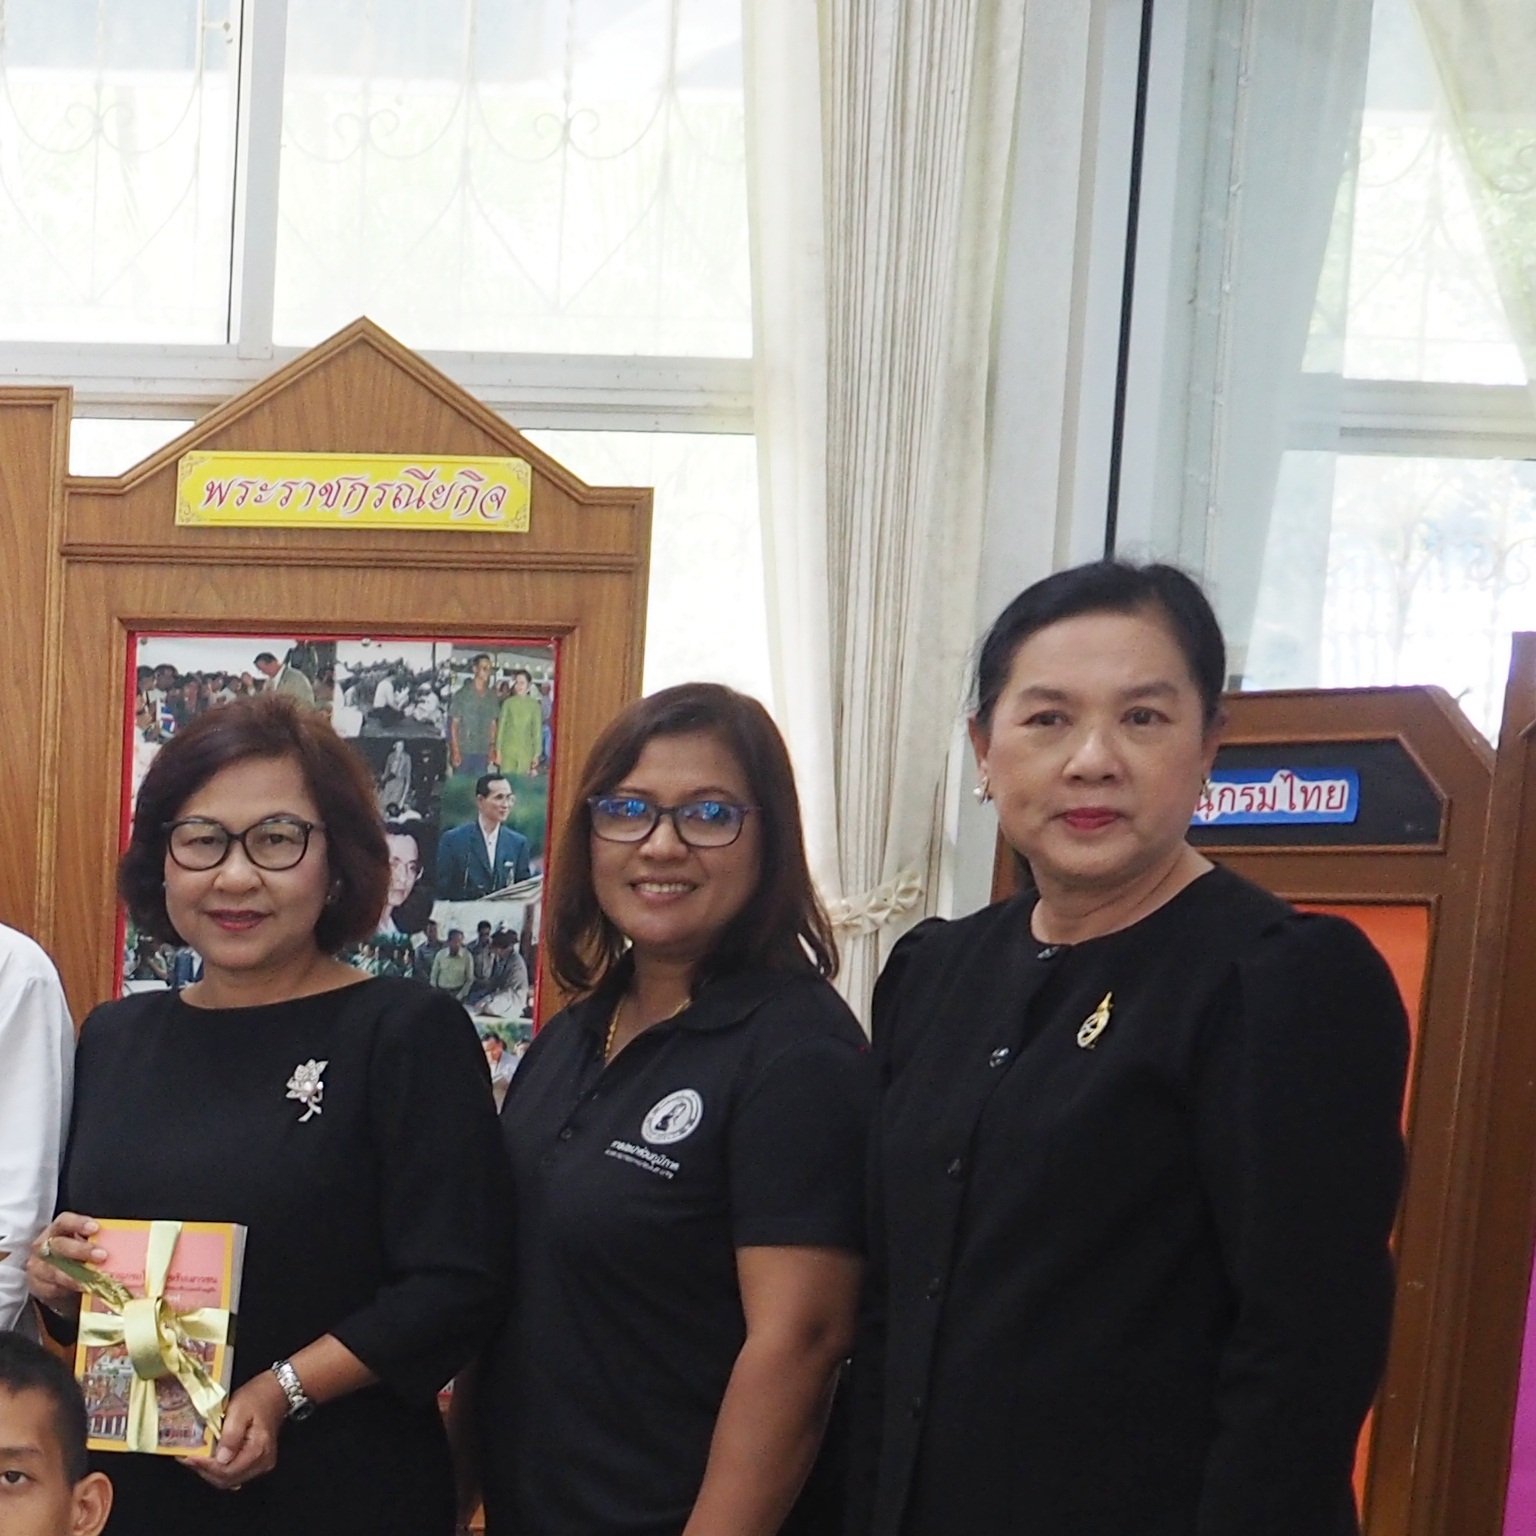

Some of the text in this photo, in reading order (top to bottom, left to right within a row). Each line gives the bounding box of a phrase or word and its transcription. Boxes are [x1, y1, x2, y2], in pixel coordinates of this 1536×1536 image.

[204, 468, 508, 519] พระราชกรณียกิจ
